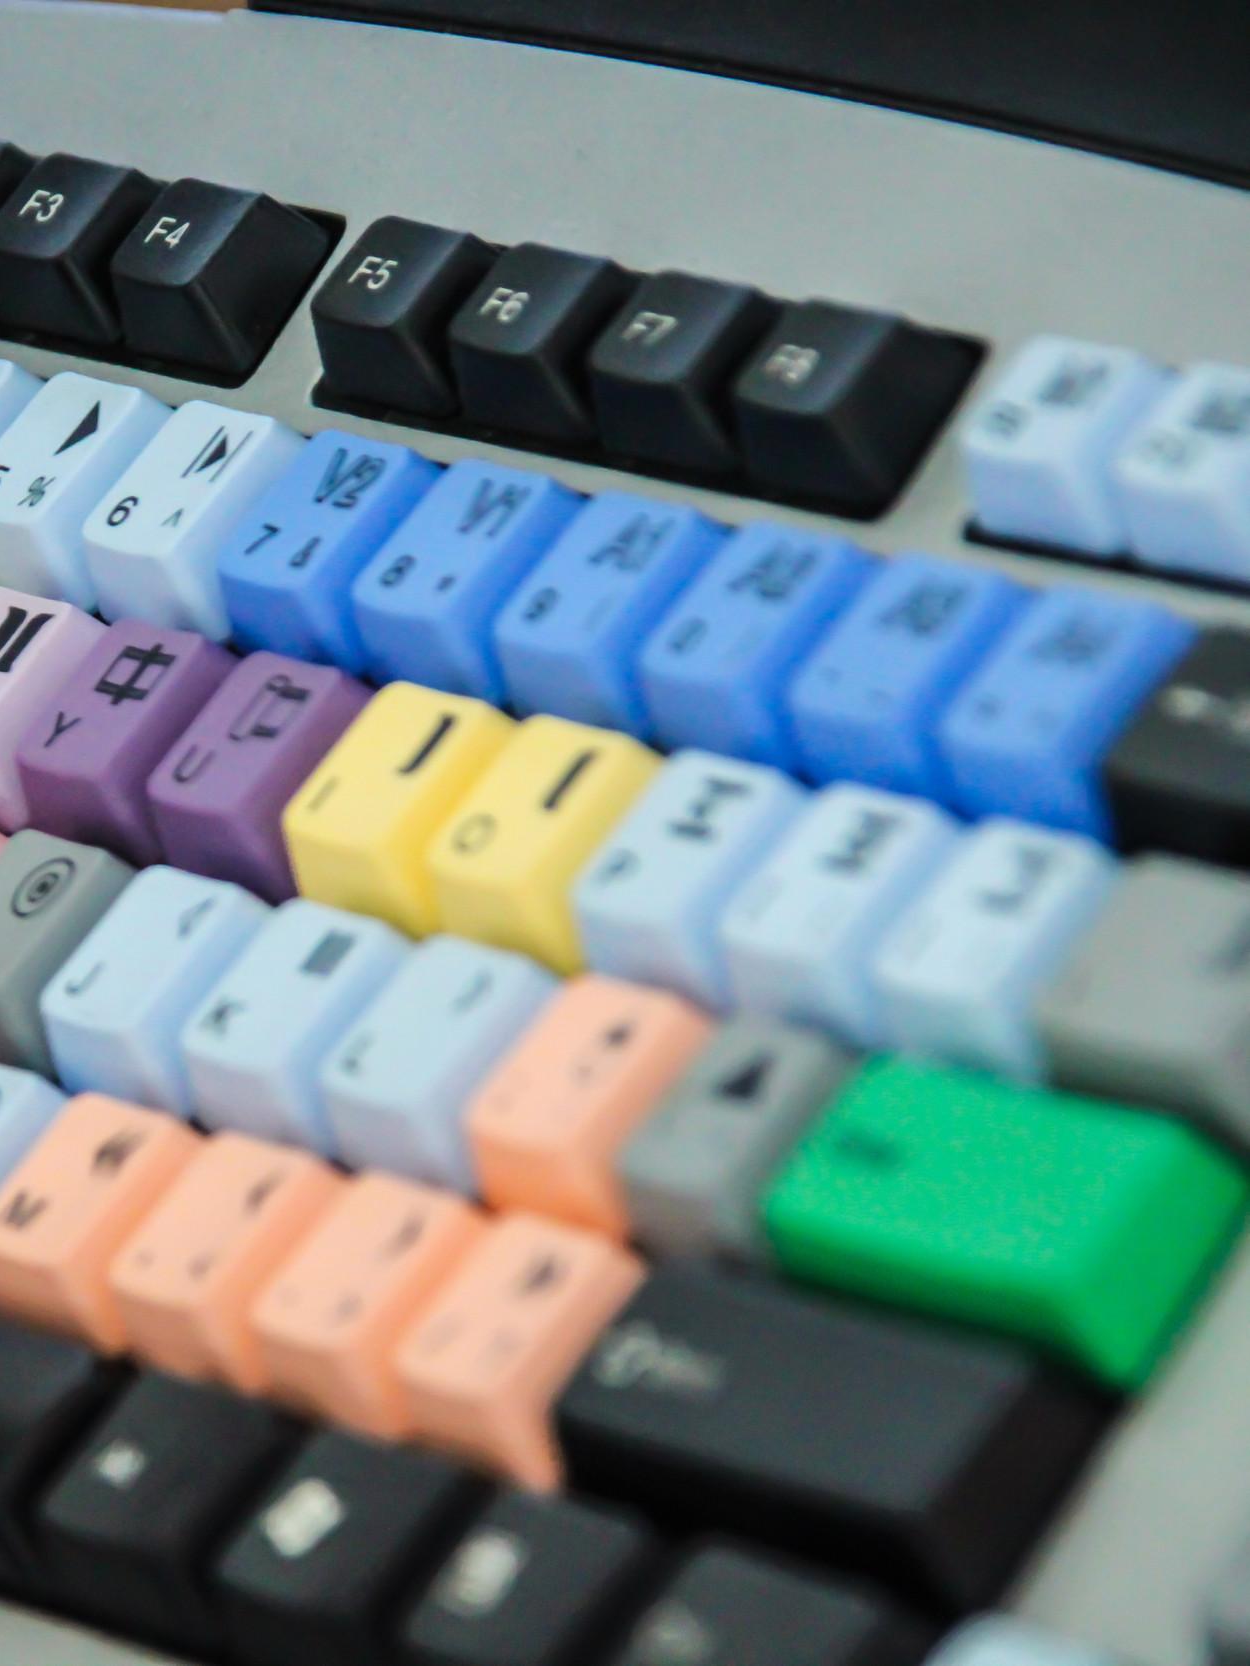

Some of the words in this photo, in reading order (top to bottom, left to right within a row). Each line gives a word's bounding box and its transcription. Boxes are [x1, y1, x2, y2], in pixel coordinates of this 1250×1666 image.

[18, 189, 64, 222] F3
[144, 216, 190, 248] F4
[347, 255, 398, 290] F5
[479, 287, 529, 322] F6
[622, 312, 678, 346] F7
[107, 496, 138, 527] 6
[244, 523, 280, 555] 7
[44, 711, 81, 747] Y
[174, 746, 216, 784] U
[451, 814, 497, 855] O
[65, 961, 101, 996] J
